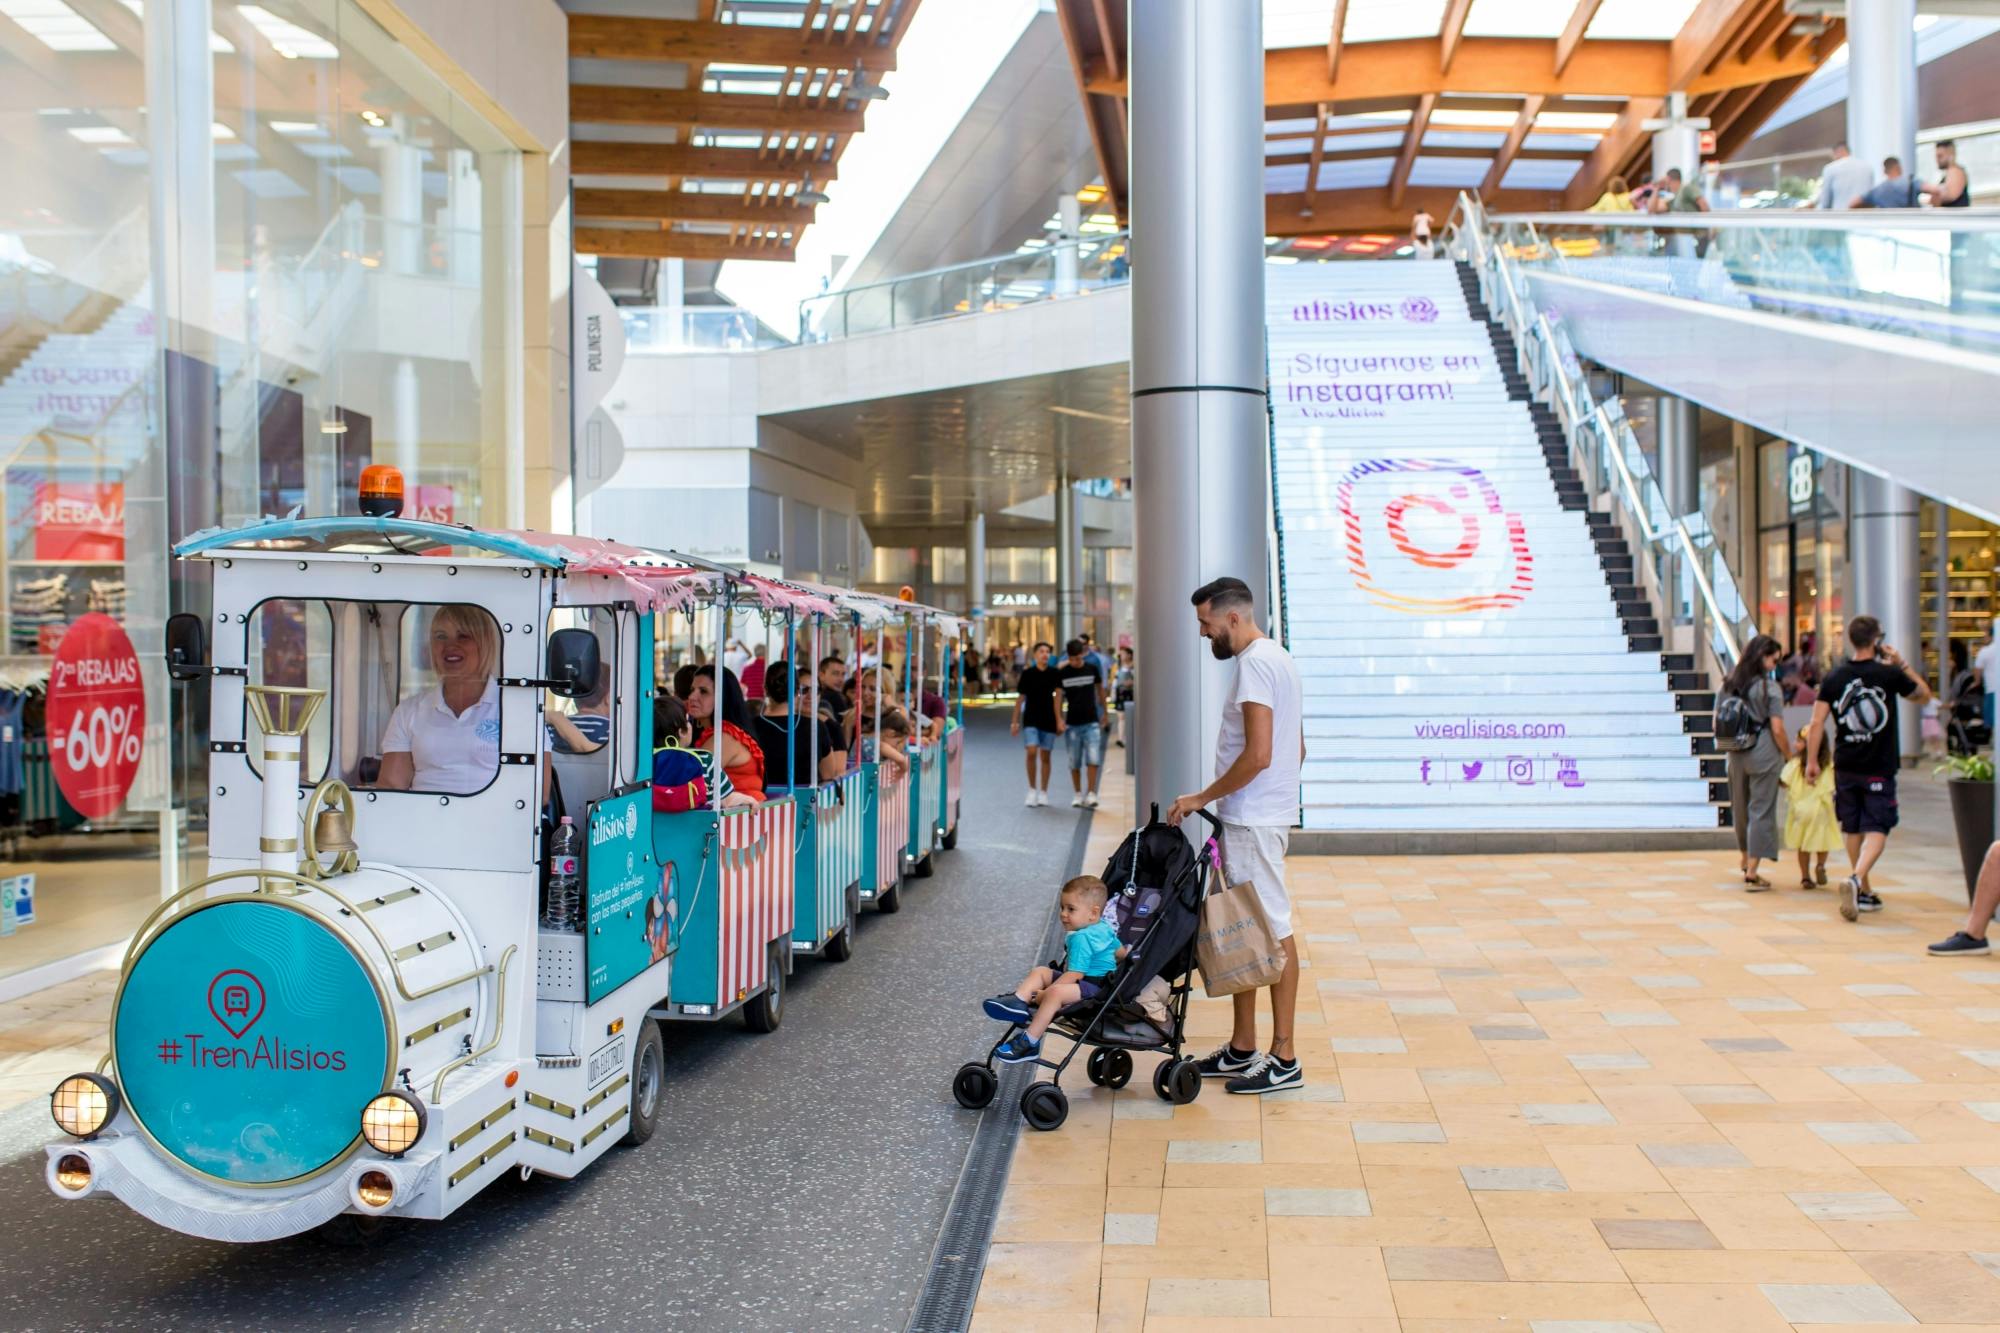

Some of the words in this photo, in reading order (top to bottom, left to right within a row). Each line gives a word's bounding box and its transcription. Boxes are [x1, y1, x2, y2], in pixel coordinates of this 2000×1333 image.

[1293, 299, 1394, 321] alisios
[588, 315, 601, 372] POLINESIA
[1443, 354, 1481, 371] en
[1288, 380, 1455, 404] Instagram!
[992, 594, 1040, 606] ZARA
[77, 657, 136, 686] REBAJAS
[1415, 717, 1566, 739] vivealisios.com
[592, 813, 625, 846] alisios
[591, 889, 611, 908] Disfruta
[611, 881, 620, 898] del
[591, 910, 601, 925] con
[602, 904, 610, 918] los
[620, 889, 643, 912] pequeños
[157, 1034, 347, 1071] #TrenAlisios
[590, 1058, 601, 1082] 100%
